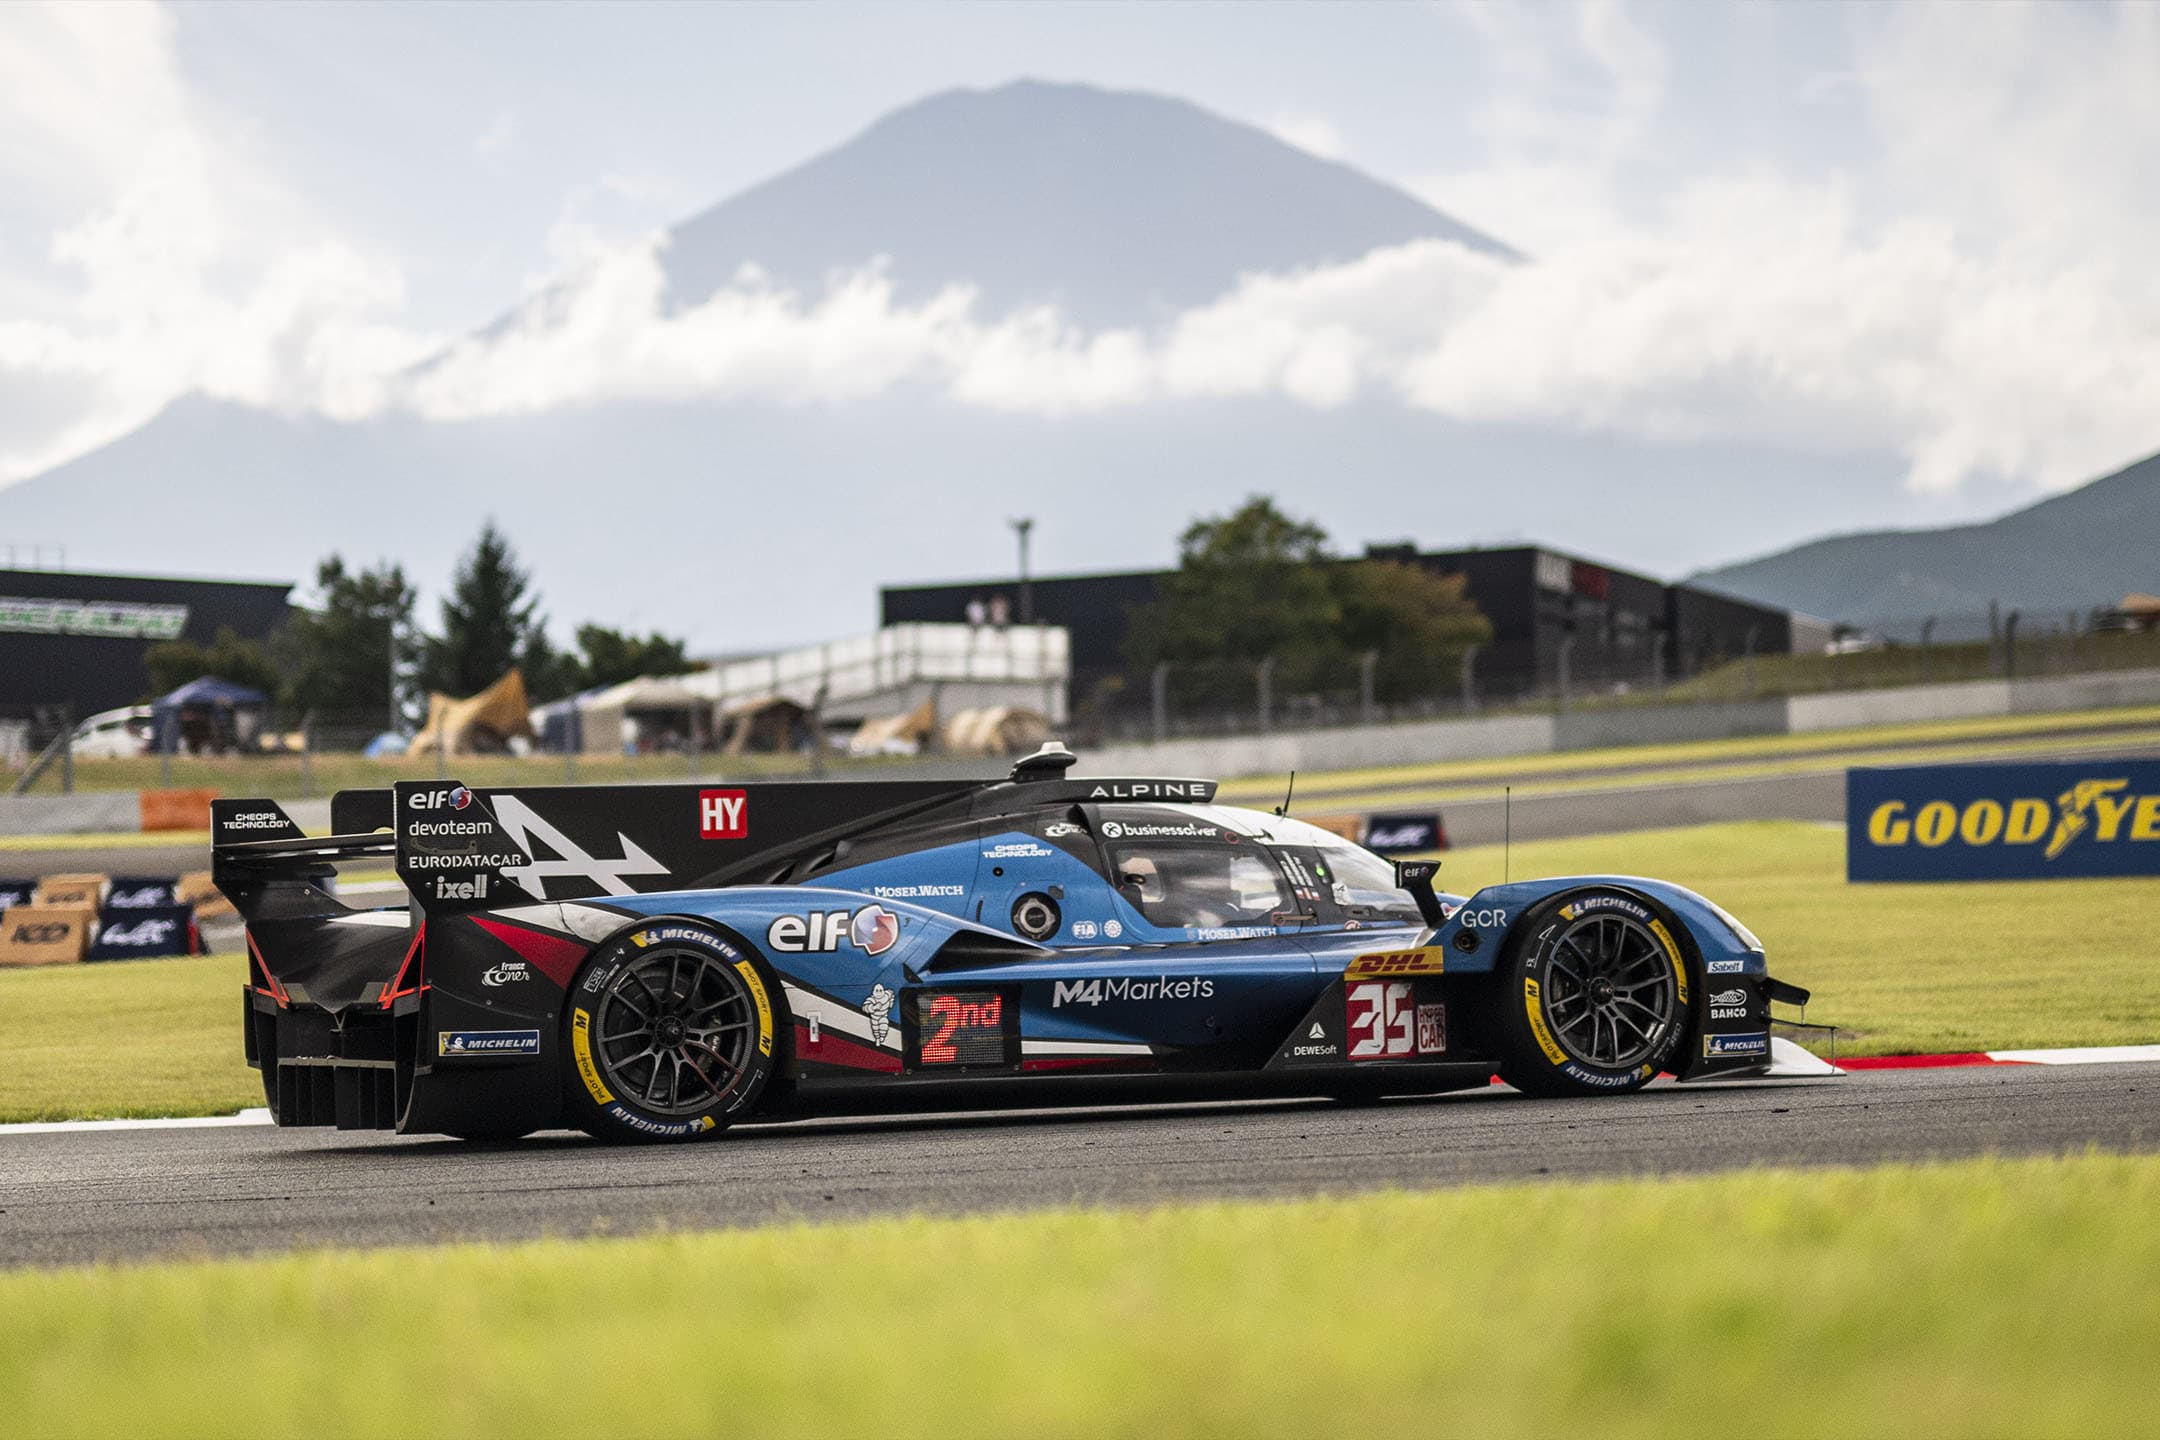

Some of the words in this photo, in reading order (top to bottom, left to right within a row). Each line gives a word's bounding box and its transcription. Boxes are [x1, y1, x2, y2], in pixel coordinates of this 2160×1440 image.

[409, 790, 448, 809] elf
[1090, 784, 1206, 798] ALPINE
[235, 813, 276, 821] CHEOPS
[701, 798, 744, 830] HY
[223, 821, 290, 829] TECHNOLOGY
[409, 821, 492, 836] devoteam
[1122, 822, 1217, 836] businessolver
[409, 854, 522, 868] EURODATACAR
[982, 850, 1053, 858] TECHNOLOGY
[1404, 868, 1419, 877] elf
[436, 875, 488, 899] ixell
[1584, 898, 1649, 918] MICHELIN
[1461, 910, 1507, 928] GCR
[769, 911, 850, 952] elf
[1073, 924, 1096, 936] FIA
[662, 929, 737, 958] MICHELIN
[1358, 953, 1430, 974] DHL
[744, 966, 759, 987] PILOT
[757, 988, 768, 1014] SPORT
[576, 1014, 587, 1030] M
[1349, 984, 1414, 1055] 35
[1711, 1008, 1747, 1019] BAHCO
[921, 994, 1002, 1063] 2nd
[1420, 1023, 1445, 1048] CAR
[467, 1039, 537, 1049] MICHELIN
[761, 1035, 771, 1050] M
[1294, 1045, 1337, 1056] DEWESoft
[1566, 1065, 1631, 1086] MICHELIN
[611, 1106, 687, 1135] MICHELIN
